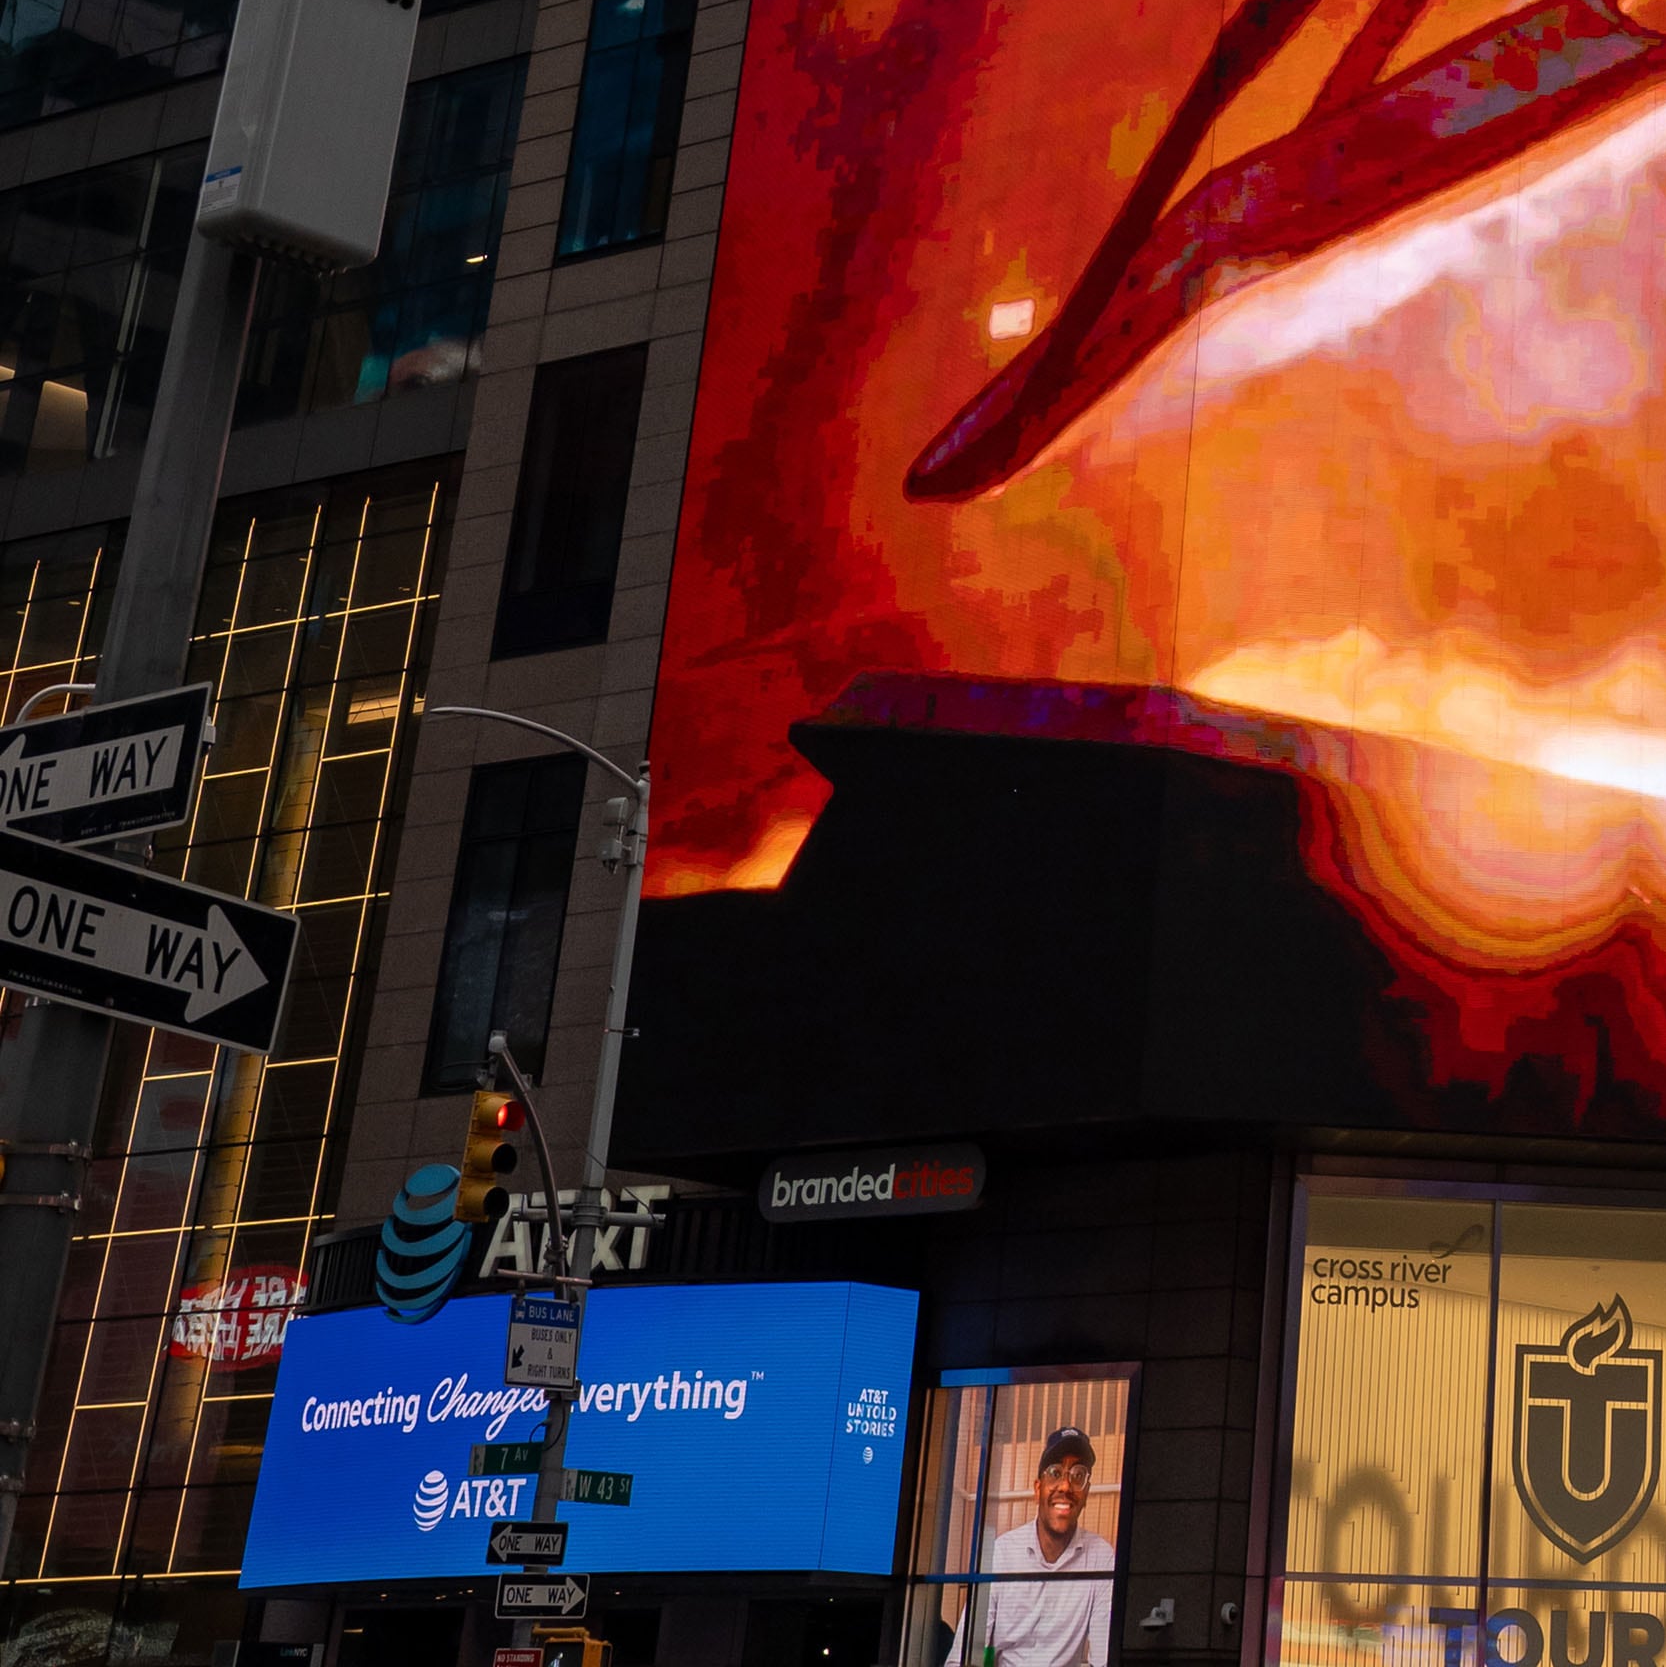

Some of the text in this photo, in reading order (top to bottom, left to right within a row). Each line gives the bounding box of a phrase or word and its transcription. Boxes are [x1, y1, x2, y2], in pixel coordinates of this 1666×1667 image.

[0, 735, 168, 815] NE WAY
[7, 885, 242, 994] ONE WAY
[1312, 1255, 1453, 1284] cross river
[1311, 1283, 1420, 1314] campus
[528, 1306, 575, 1323] BUS LANE
[531, 1327, 574, 1344] BUSES ONLY
[527, 1363, 570, 1380] RIGHT TURNS
[302, 1386, 421, 1433] Connecting
[427, 1372, 550, 1441] Changes
[570, 1370, 747, 1422] verything
[859, 1388, 889, 1405] AT&T
[847, 1402, 897, 1421] UNTOLD
[846, 1419, 896, 1437] STORIES
[501, 1447, 509, 1470] 7
[513, 1446, 529, 1462] Av
[579, 1474, 592, 1498] W
[596, 1476, 614, 1500] 43
[450, 1478, 527, 1519] AT&T
[499, 1535, 560, 1552] ONE WAY
[506, 1586, 576, 1604] ONE WAY
